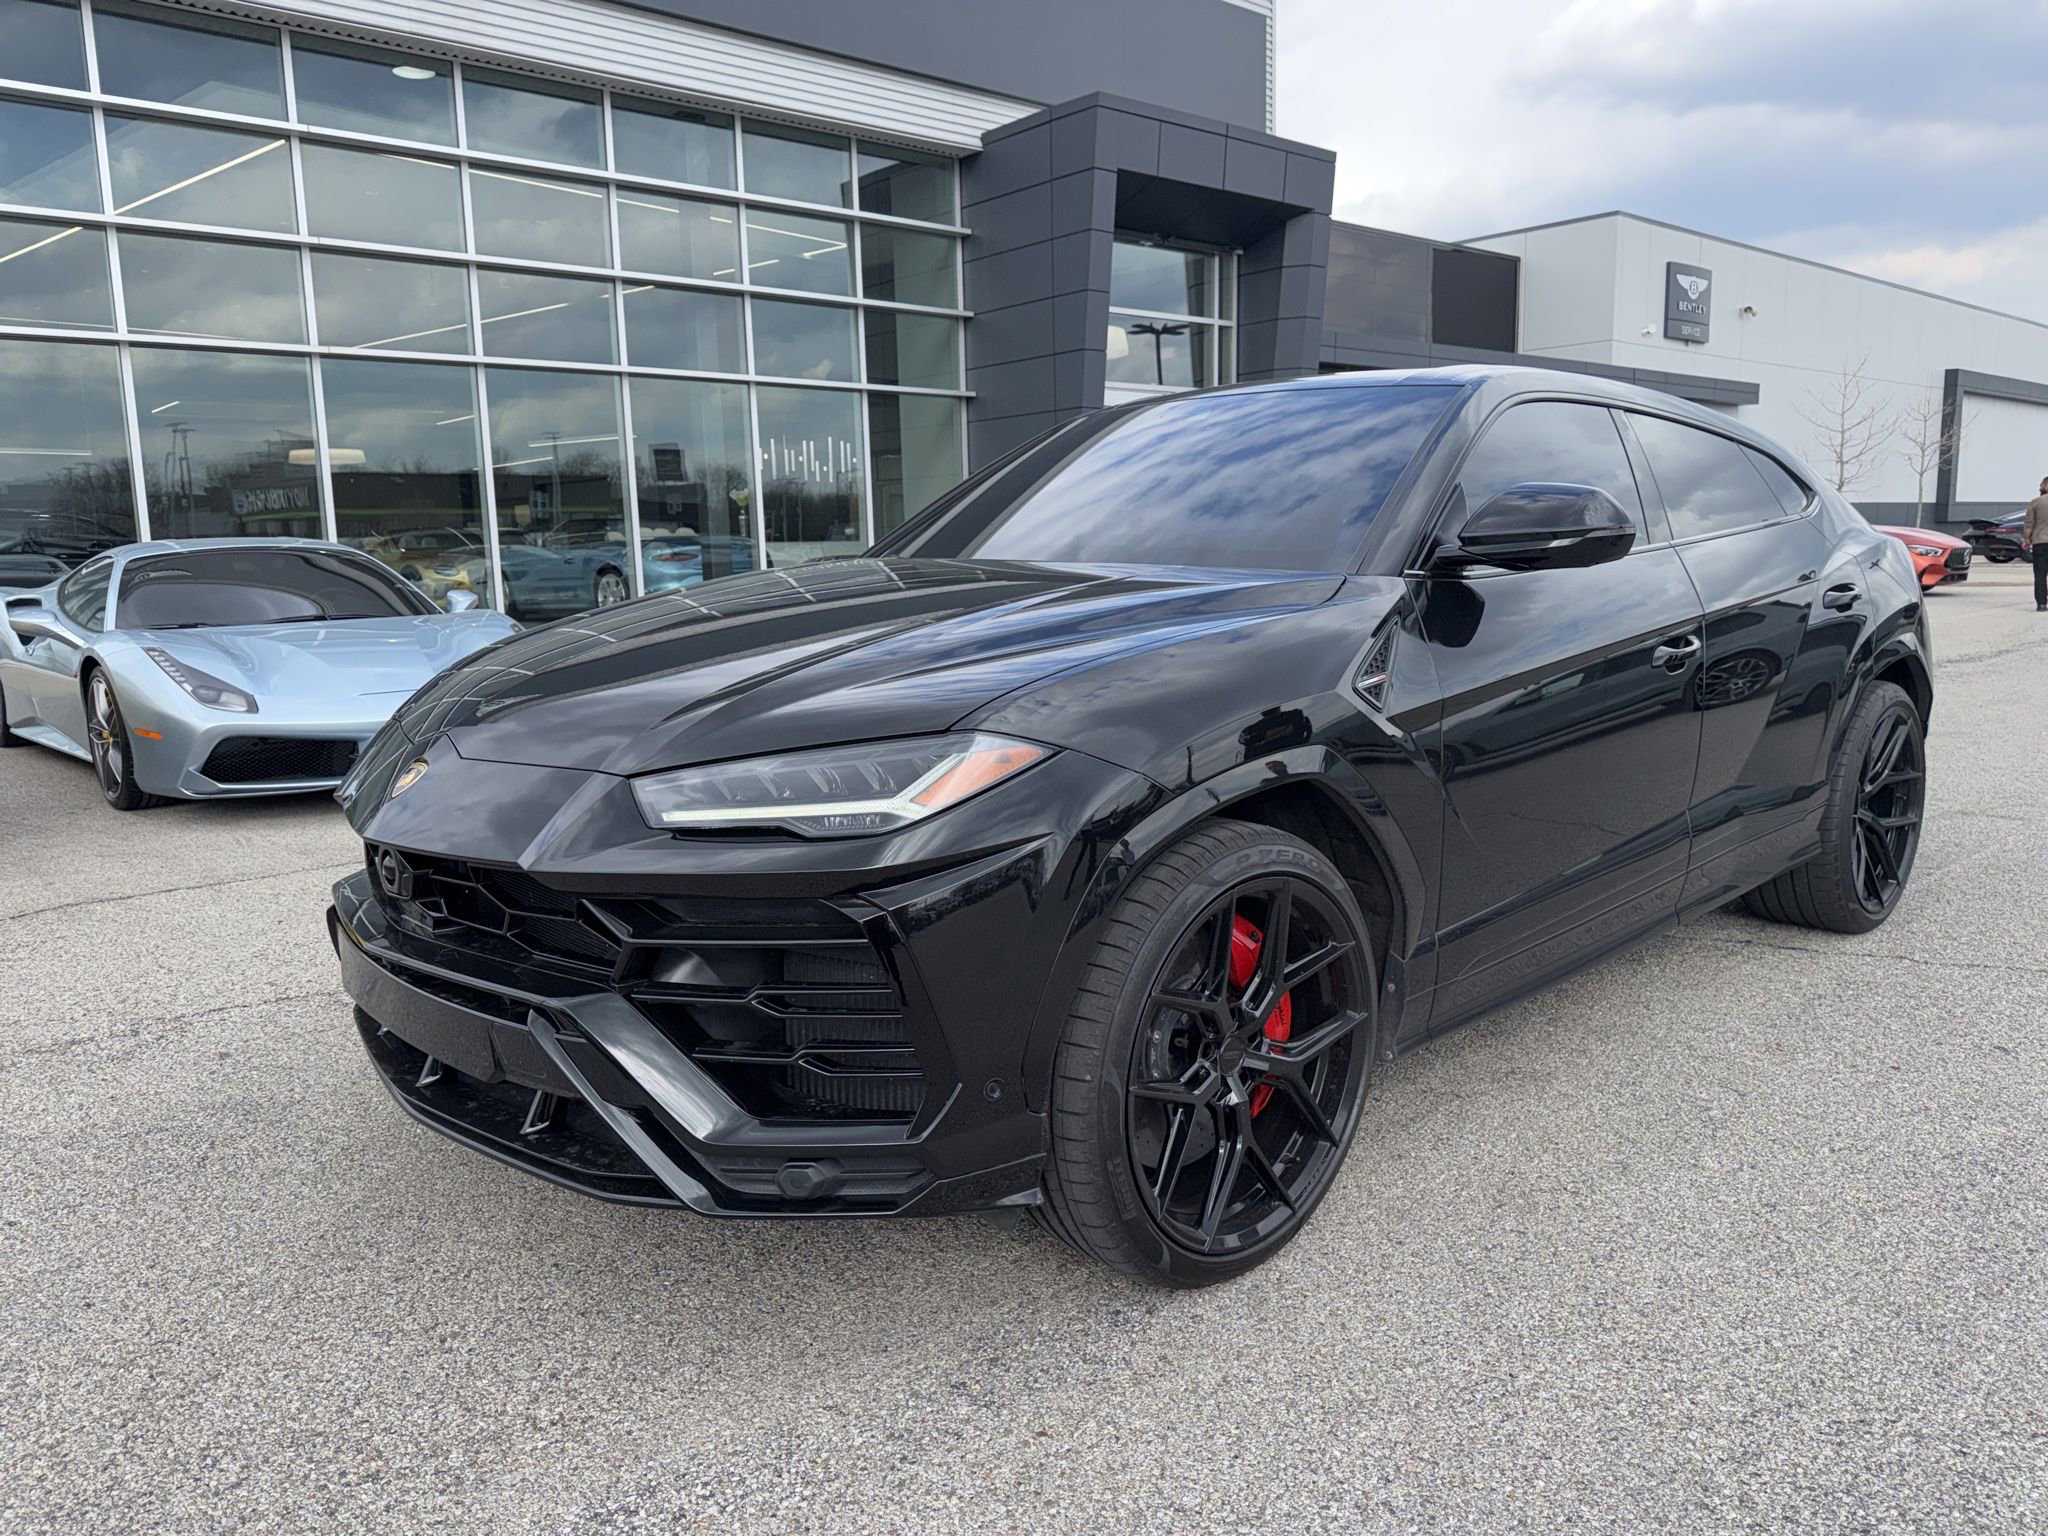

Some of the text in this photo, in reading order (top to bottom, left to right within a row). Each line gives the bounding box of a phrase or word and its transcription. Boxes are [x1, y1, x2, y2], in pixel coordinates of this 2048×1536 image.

[1678, 301, 1706, 314] BENTLEY
[1235, 849, 1322, 872] P ZERO
